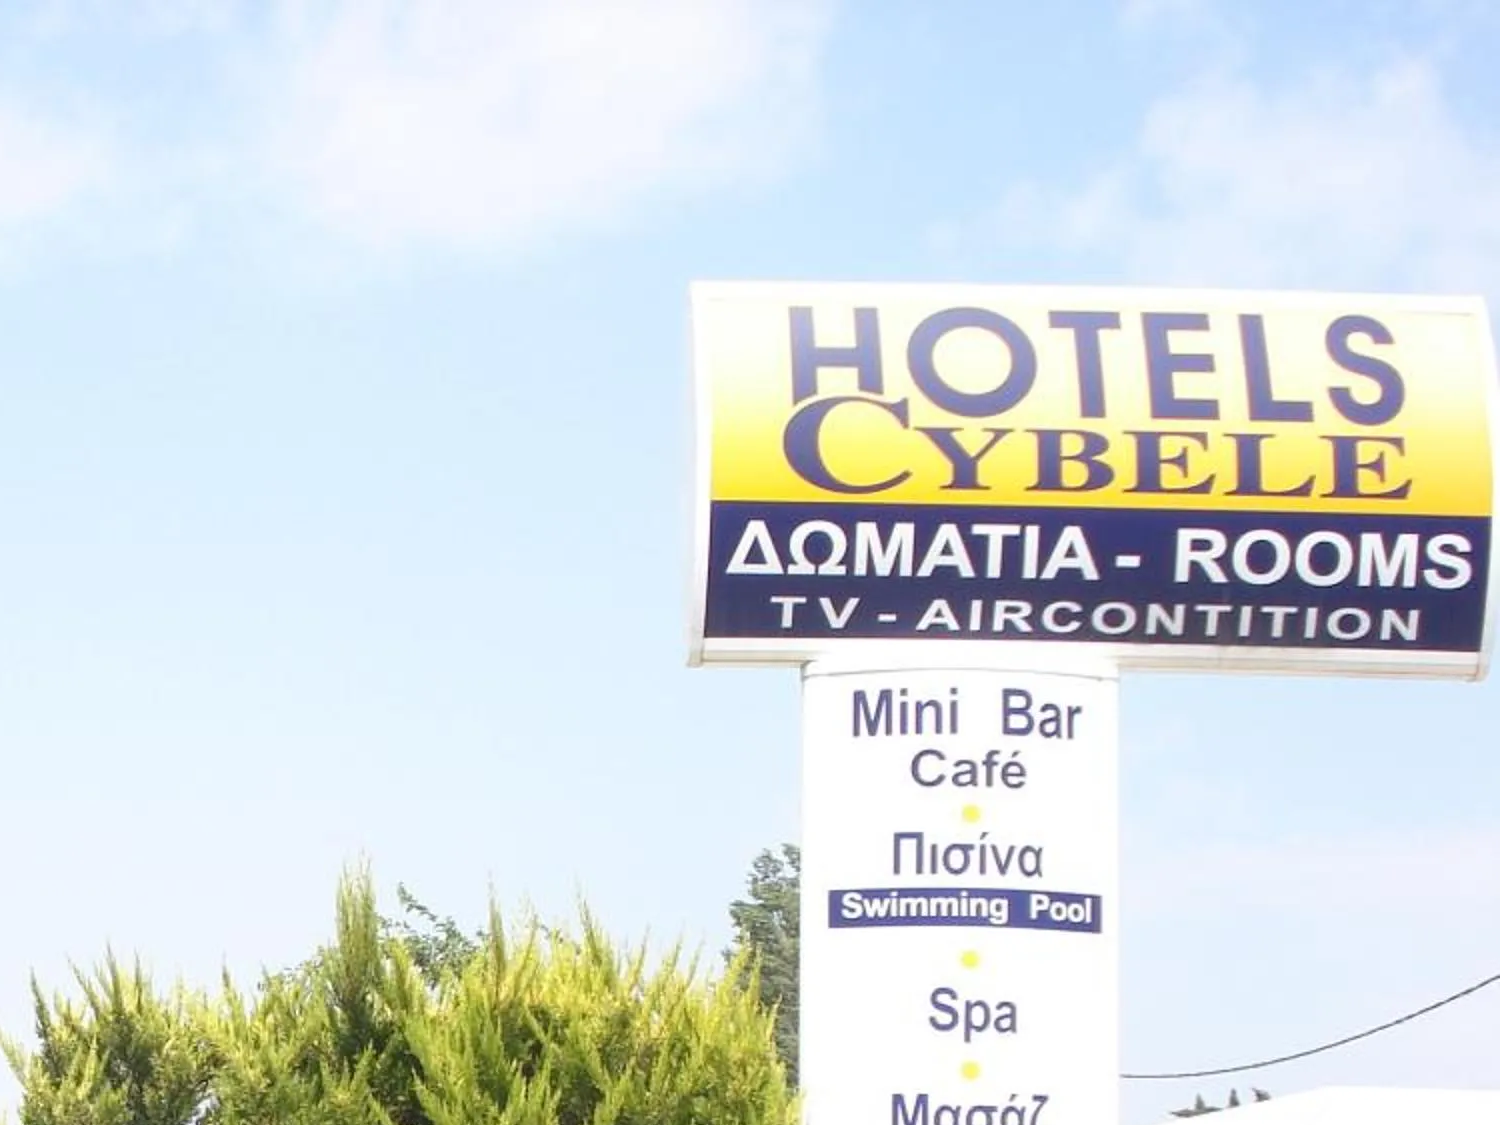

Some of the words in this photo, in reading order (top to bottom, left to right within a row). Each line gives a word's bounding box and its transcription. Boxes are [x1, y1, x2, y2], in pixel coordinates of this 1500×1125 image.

[787, 305, 1407, 427] HOTELS
[782, 395, 1414, 501] CYBELE
[726, 519, 1099, 581] ΔΩΜΑΤΙΑ
[1175, 528, 1473, 589] ROOMS
[770, 596, 860, 629] TV
[917, 598, 1421, 642] AIRCONTITION
[852, 687, 958, 738] Mini
[1001, 687, 1083, 740] Bar
[910, 748, 1027, 789] Café
[893, 831, 1043, 878] Πισίνα
[841, 891, 1009, 924] Swimming
[1029, 894, 1093, 924] Pool
[928, 987, 1017, 1043] Spa
